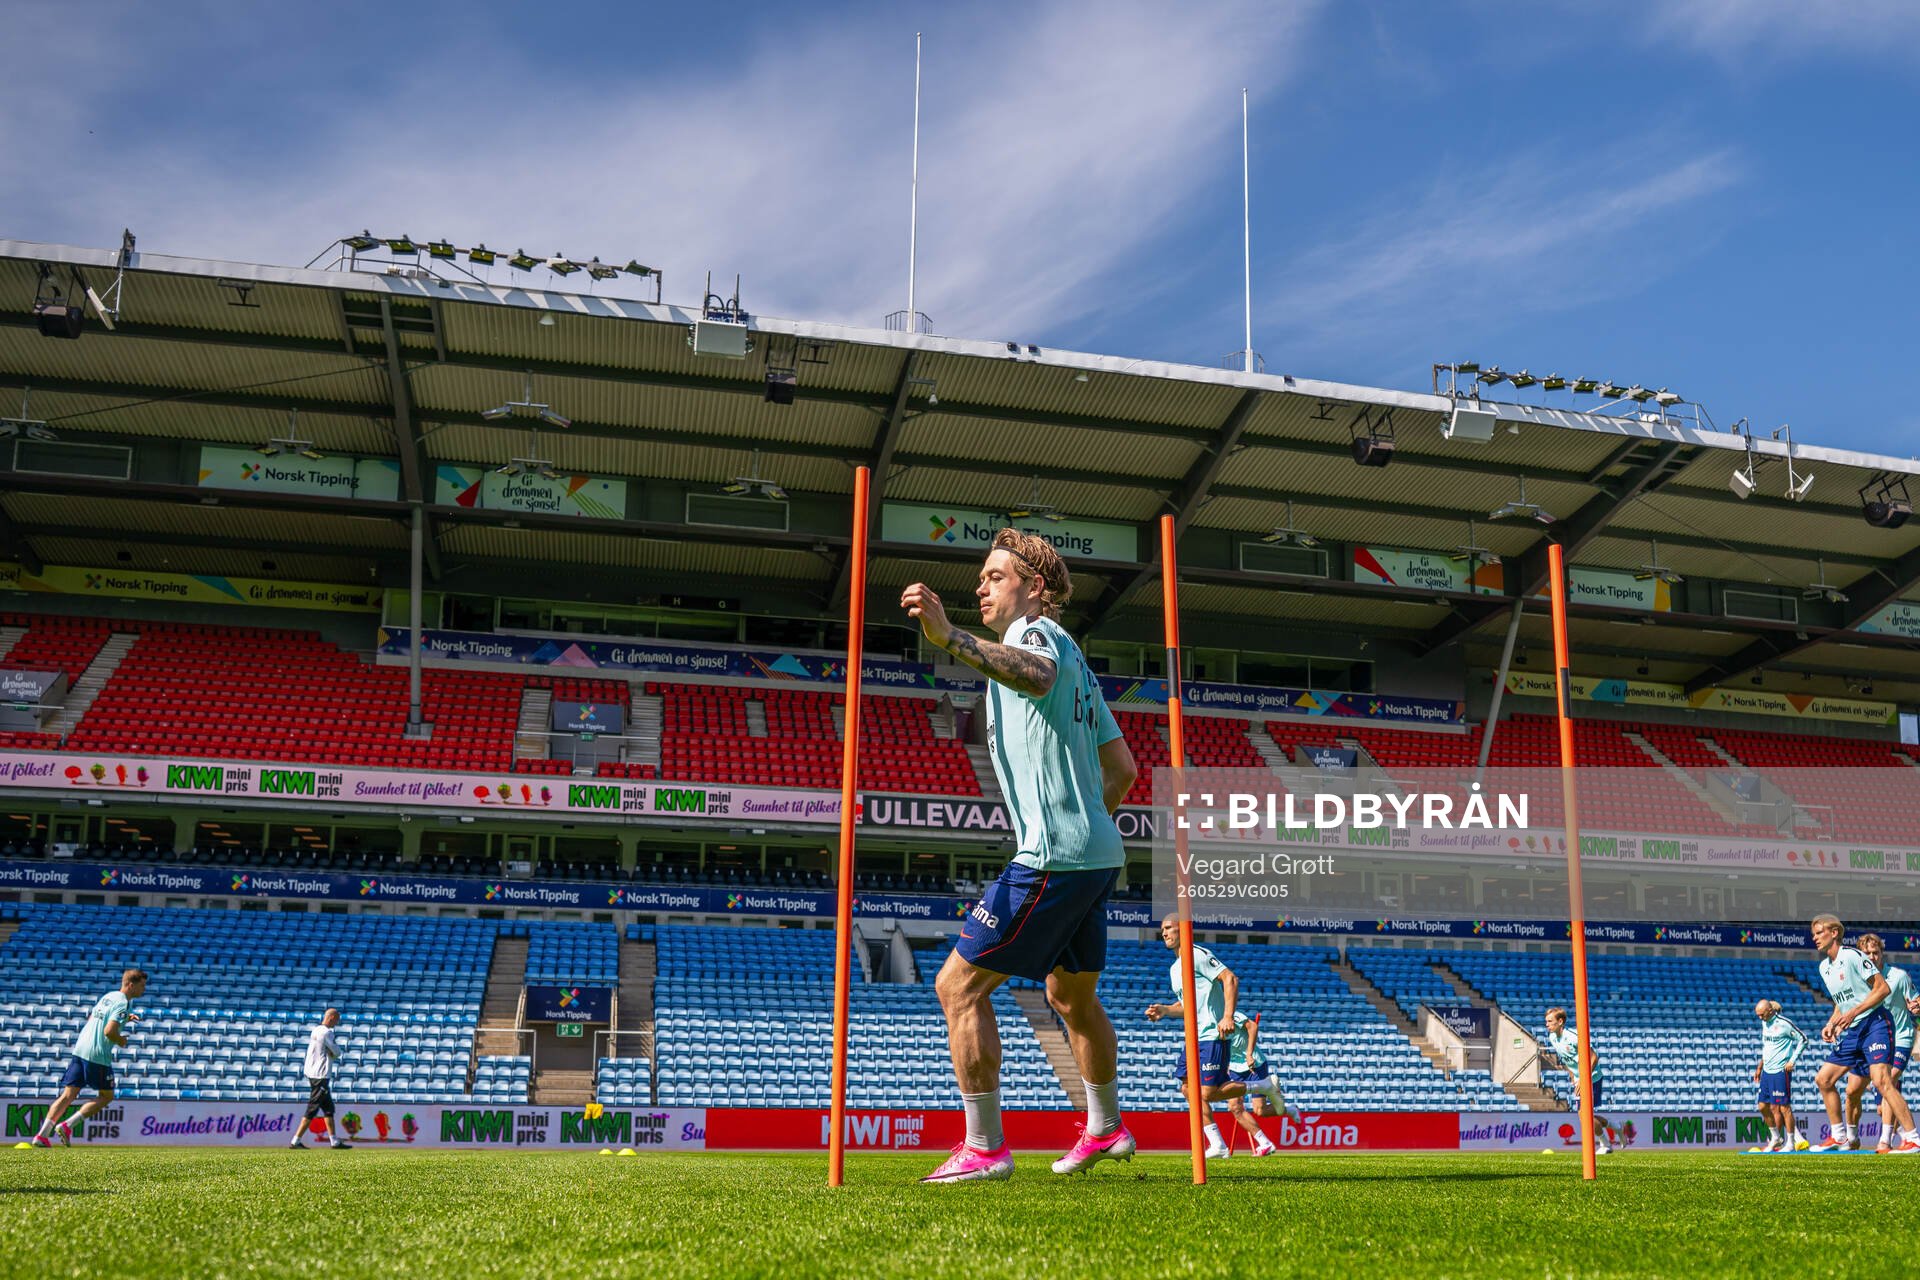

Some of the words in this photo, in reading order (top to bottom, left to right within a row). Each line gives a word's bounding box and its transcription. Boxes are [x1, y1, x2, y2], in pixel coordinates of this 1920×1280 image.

[265, 468, 305, 483] Norsk
[309, 471, 360, 488] Tipping
[522, 474, 533, 486] Gi
[512, 498, 523, 506] en
[963, 523, 998, 540] Nor
[1023, 528, 1093, 554] Tpping
[105, 578, 141, 590] Norsk
[144, 580, 188, 595] Tipping
[249, 585, 262, 598] Gi
[1577, 583, 1606, 595] Norsk
[1607, 586, 1644, 601] Tipping
[431, 639, 466, 652] Norsk
[468, 641, 512, 657] Tipping
[611, 648, 624, 663] Gi
[675, 655, 688, 666] en
[840, 664, 874, 678] Nsk
[874, 667, 916, 683] Tipping
[1188, 687, 1201, 700] Gi
[1385, 704, 1413, 715] Norsk
[1413, 705, 1449, 720] Tipping
[1734, 698, 1757, 707] Norsk
[1758, 700, 1786, 711] Tipping
[167, 764, 224, 790] KIWI
[226, 768, 251, 781] mini
[259, 769, 316, 795] KIWI
[318, 772, 343, 786] mini
[226, 780, 249, 793] pris
[318, 785, 341, 798] pris
[354, 781, 408, 796] Sunnhet
[409, 783, 422, 795] til
[623, 787, 647, 800] mini
[568, 784, 621, 809] KIWI
[654, 787, 706, 813] KIWI
[708, 791, 731, 803] mini
[622, 799, 644, 811] pris
[708, 803, 729, 815] pris
[742, 799, 791, 814] Sunnhet
[791, 800, 803, 813] til
[870, 800, 1014, 830] ULLEVAA
[1276, 821, 1321, 844] KIWI
[1321, 833, 1340, 845] pris
[1346, 824, 1390, 847] KIWI
[1391, 827, 1411, 837] mini
[1420, 831, 1460, 847] Sunnhet
[1460, 833, 1471, 846] til
[1391, 837, 1410, 848] pris
[1579, 836, 1617, 858] KIWI
[1619, 838, 1637, 849] mini
[1642, 839, 1680, 861] KIWI
[1682, 842, 1699, 851] mini
[1619, 848, 1636, 859] pris
[1681, 851, 1698, 862] pris
[1849, 850, 1884, 870] KIWI
[1885, 851, 1901, 861] mini
[1885, 860, 1901, 871] pris
[0, 868, 23, 880] orsk
[24, 869, 70, 885] Tipping
[121, 872, 156, 886] Norsk
[157, 874, 201, 890] Tipping
[252, 877, 286, 891] Norsk
[286, 879, 330, 894] Tipping
[380, 882, 412, 895] Norsk
[412, 883, 456, 899] Tipping
[504, 888, 537, 901] Norsk
[537, 889, 580, 904] Tipping
[626, 892, 658, 905] Norsk
[659, 893, 700, 908] Tipping
[745, 896, 777, 909] Norsk
[777, 898, 817, 912] Tipping
[862, 901, 892, 912] Norsk
[893, 902, 931, 916] Tipping
[1113, 910, 1150, 924] Tipping
[1192, 913, 1218, 924] Norsk
[1218, 914, 1254, 928] Tipping
[1292, 916, 1317, 928] Norsk
[1317, 918, 1354, 931] Tipping
[1391, 920, 1415, 931] Norsk
[1415, 921, 1450, 934] Tipping
[1487, 923, 1511, 934] Norsk
[1511, 924, 1545, 937] Tipping
[1604, 927, 1635, 939] Tipping
[1668, 929, 1690, 940] Norsk
[1690, 930, 1721, 943] Tipping
[1753, 932, 1775, 942] Norsk
[1775, 933, 1805, 945] Tipping
[545, 1009, 566, 1018] Norsk
[566, 1010, 592, 1020] Tipping
[140, 1114, 214, 1137] Sunnhet
[215, 1115, 233, 1135] til
[440, 1110, 513, 1144] KIWI
[516, 1111, 549, 1128] mini
[560, 1110, 632, 1144] KIWI
[634, 1112, 666, 1129] mini
[895, 1115, 924, 1131] mini
[1705, 1117, 1728, 1130] mini
[88, 1122, 120, 1141] pris
[516, 1128, 547, 1146] pris
[634, 1129, 665, 1146] pris
[1494, 1124, 1508, 1139] til
[1652, 1117, 1704, 1144] KIWI
[1705, 1130, 1727, 1146] pris
[895, 1130, 921, 1149] pris
